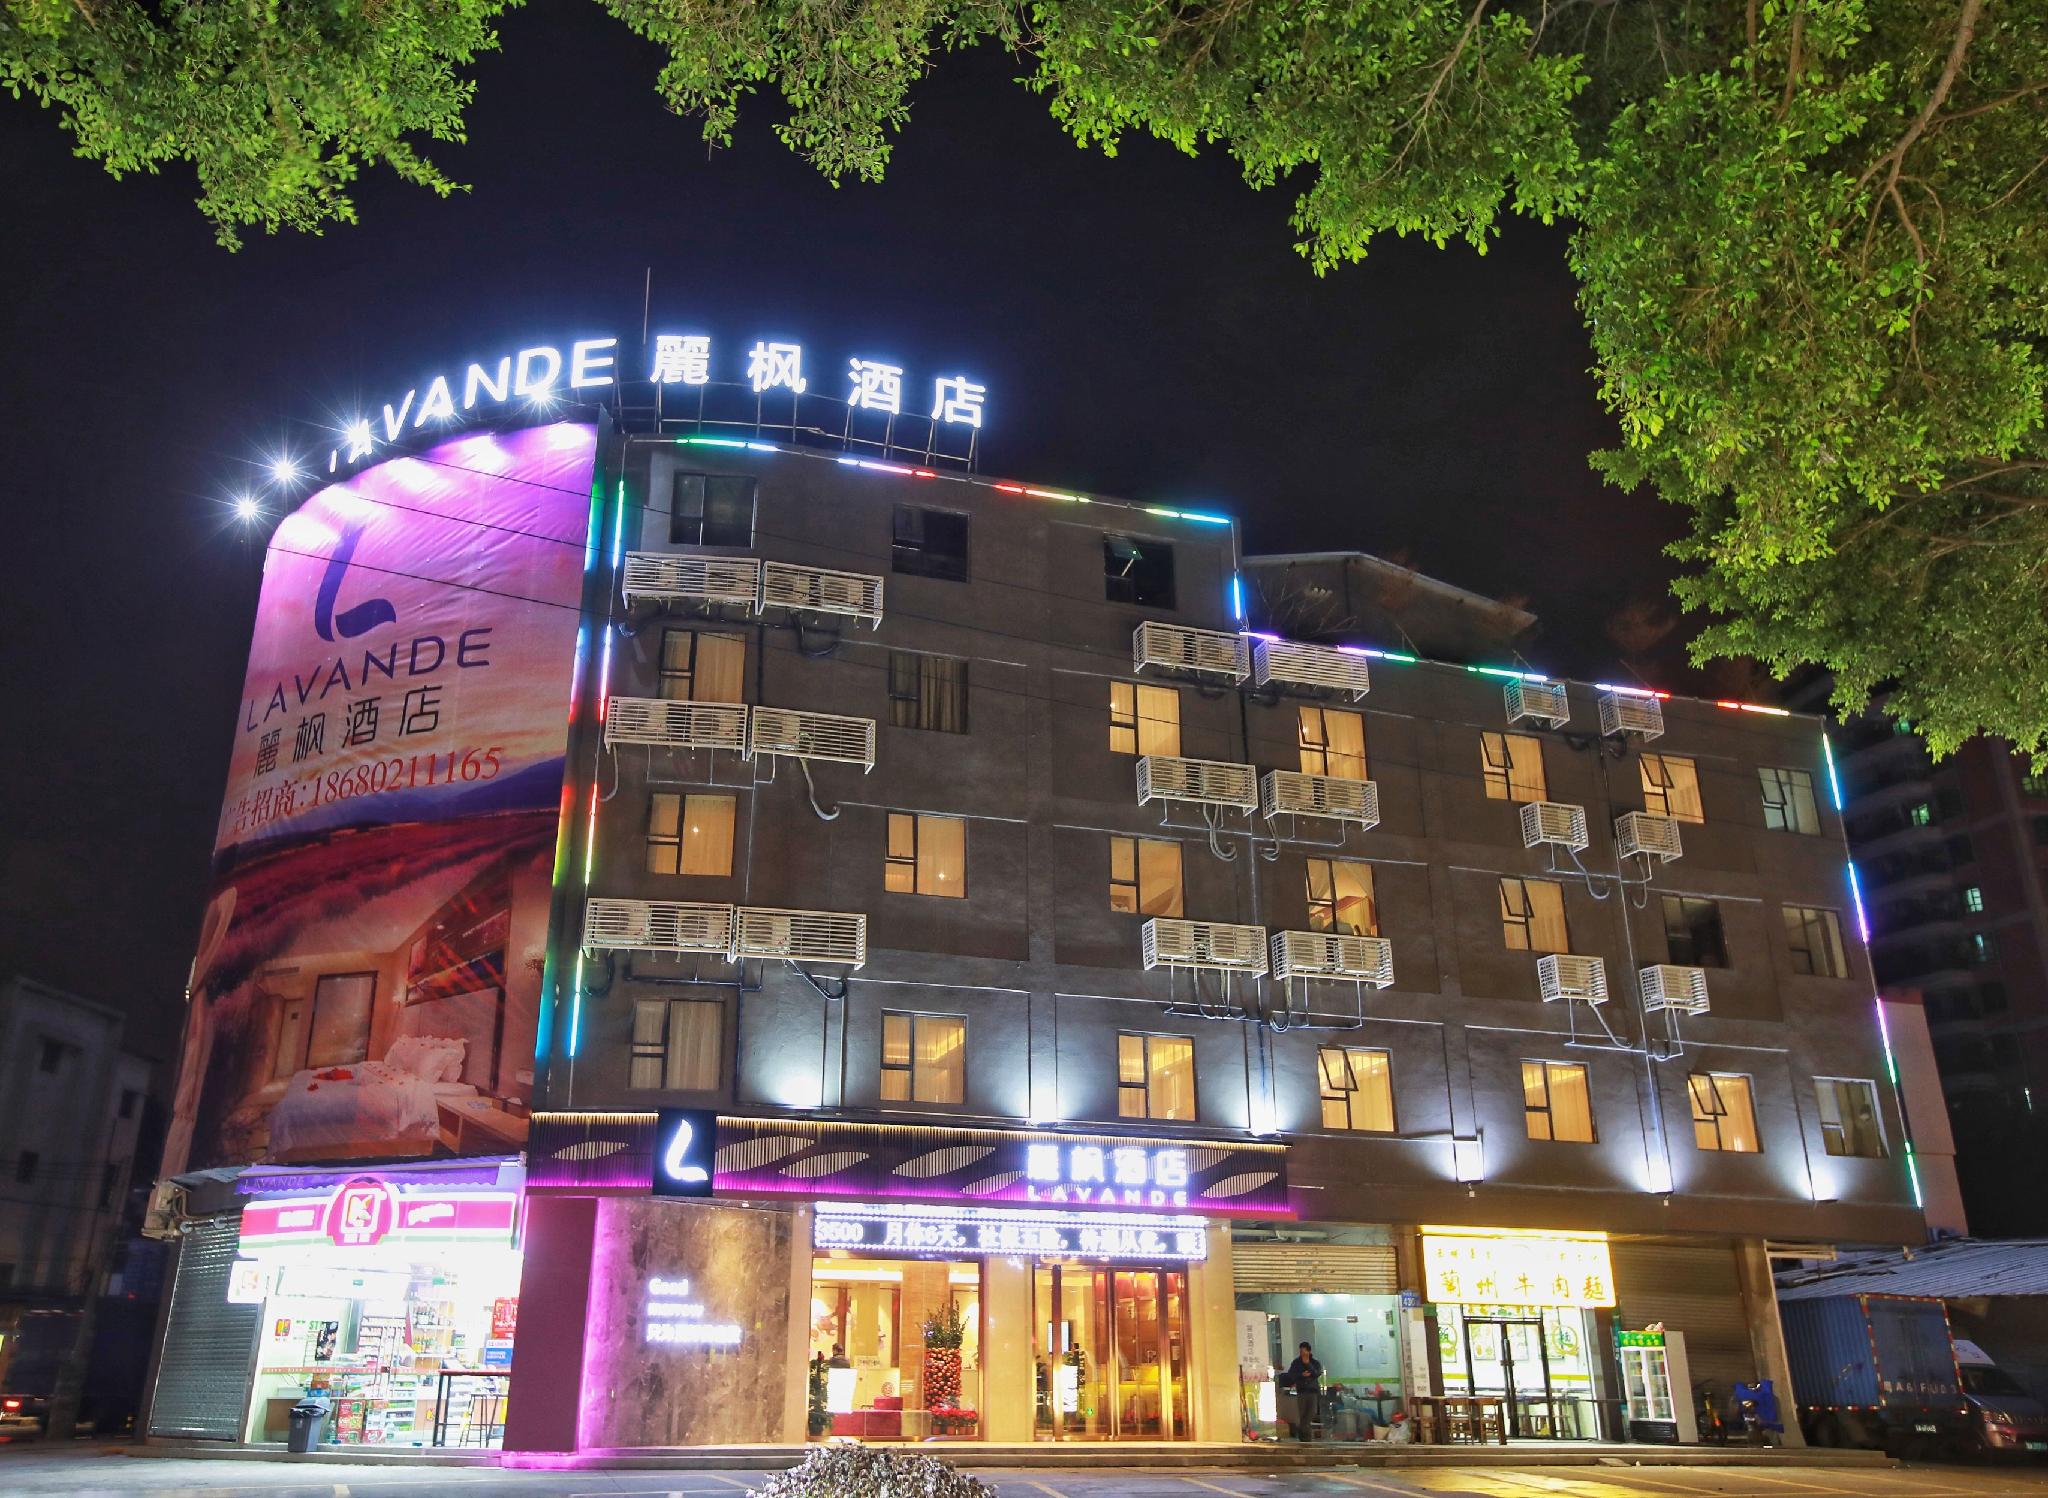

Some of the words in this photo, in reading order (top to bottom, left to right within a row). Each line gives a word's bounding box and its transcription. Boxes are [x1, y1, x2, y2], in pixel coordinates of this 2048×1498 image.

[650, 335, 986, 428] 麗枫酒店
[246, 627, 493, 733] LAVANDE
[252, 684, 443, 779] 麗枫酒店
[1027, 1184, 1188, 1208] LAVANDE
